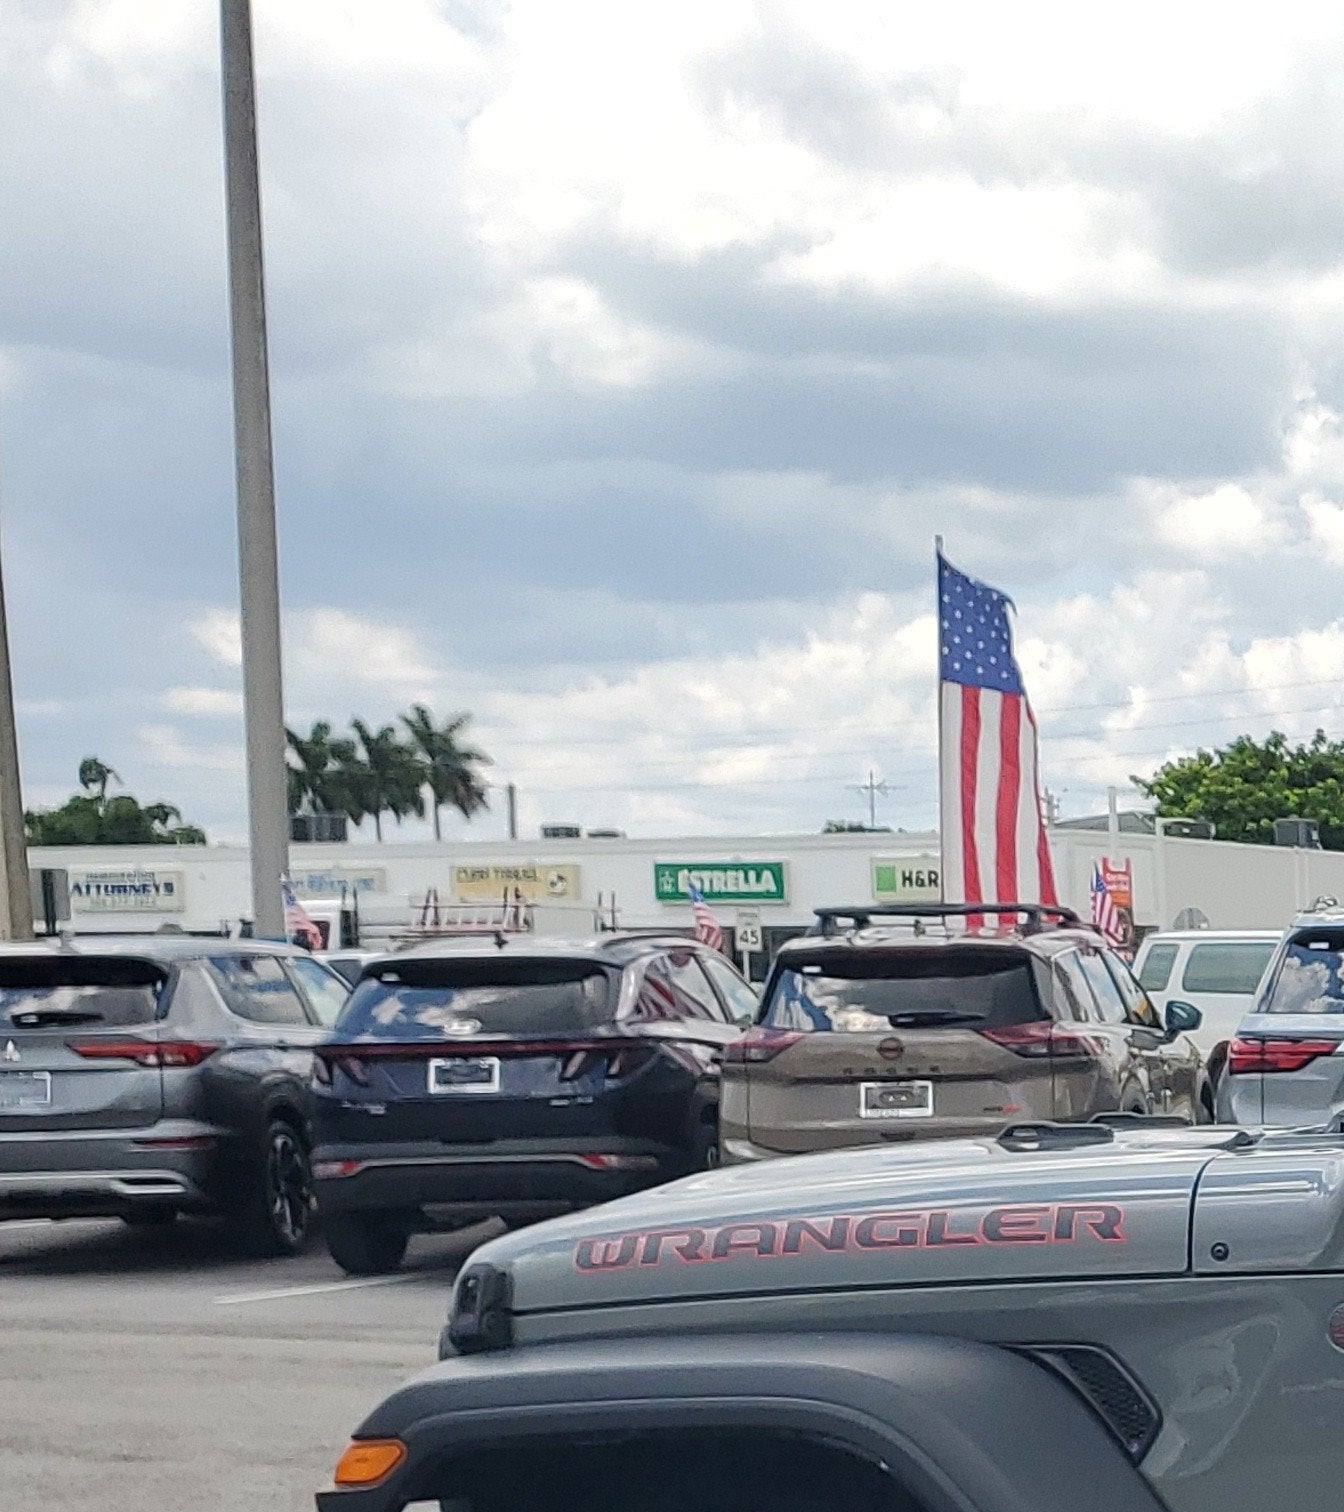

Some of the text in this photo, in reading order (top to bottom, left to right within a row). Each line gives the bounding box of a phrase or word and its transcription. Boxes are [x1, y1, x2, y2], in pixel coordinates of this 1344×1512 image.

[677, 868, 778, 894] ESTRELLA
[901, 869, 939, 888] H&R
[740, 929, 759, 945] 45
[574, 1202, 1127, 1274] WRANGLER
